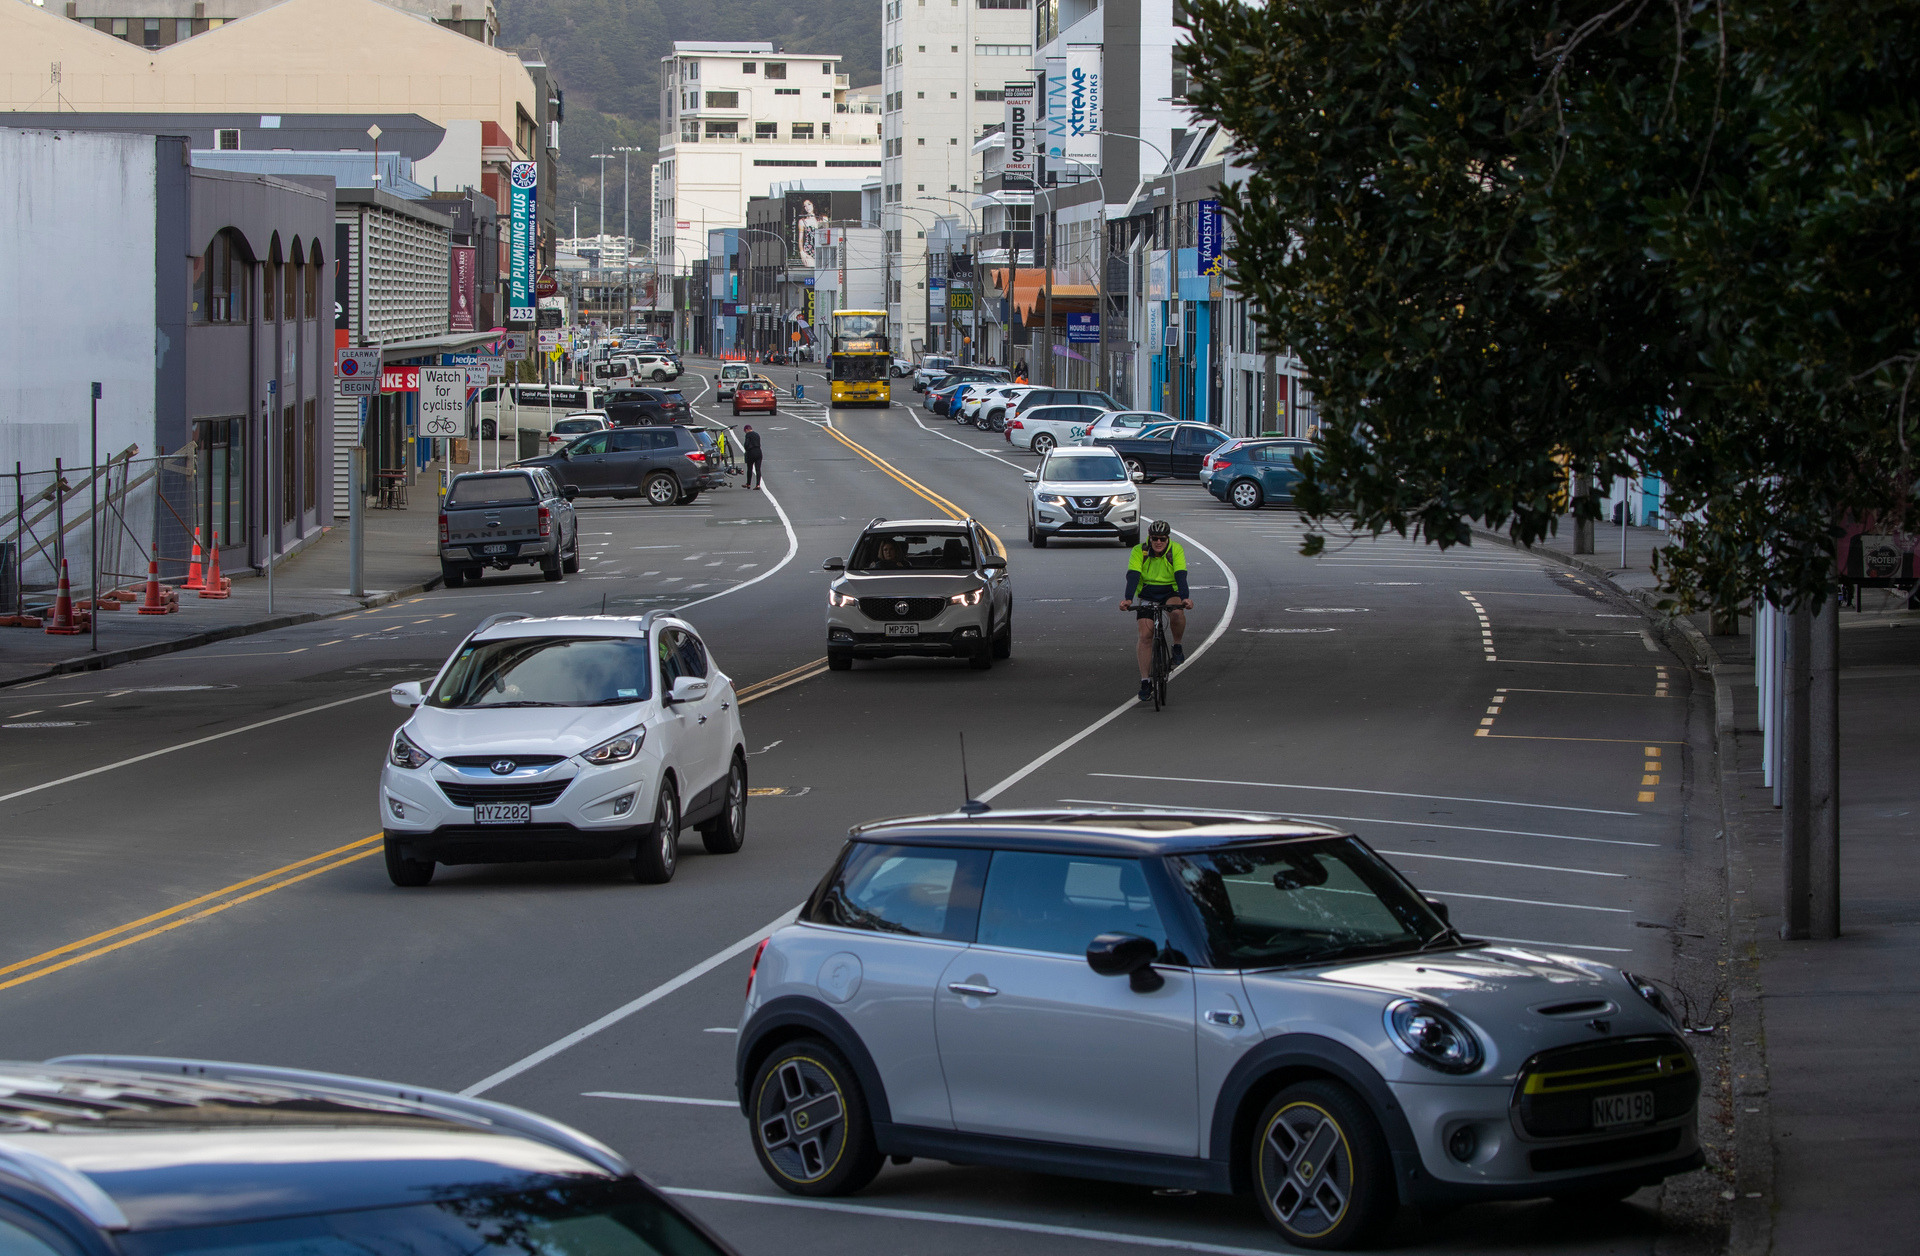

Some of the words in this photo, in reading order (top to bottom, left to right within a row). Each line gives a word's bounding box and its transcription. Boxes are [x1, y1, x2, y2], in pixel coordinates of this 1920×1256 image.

[1068, 68, 1087, 137] xtreme
[1090, 73, 1098, 132] NETWORKS
[513, 164, 535, 178] PLUMBNG
[513, 193, 526, 219] PLUS
[1203, 204, 1212, 262] TRADESTAFF
[513, 222, 526, 278] PLUMBING
[513, 281, 524, 300] ZIP
[951, 294, 973, 307] BEDS
[513, 308, 533, 319] 232
[426, 370, 461, 382] Watch
[436, 385, 450, 396] for
[423, 400, 462, 412] cyclists
[451, 528, 538, 540] RANGER
[477, 805, 528, 819] HYZ202
[1595, 1094, 1652, 1124] NKC198
